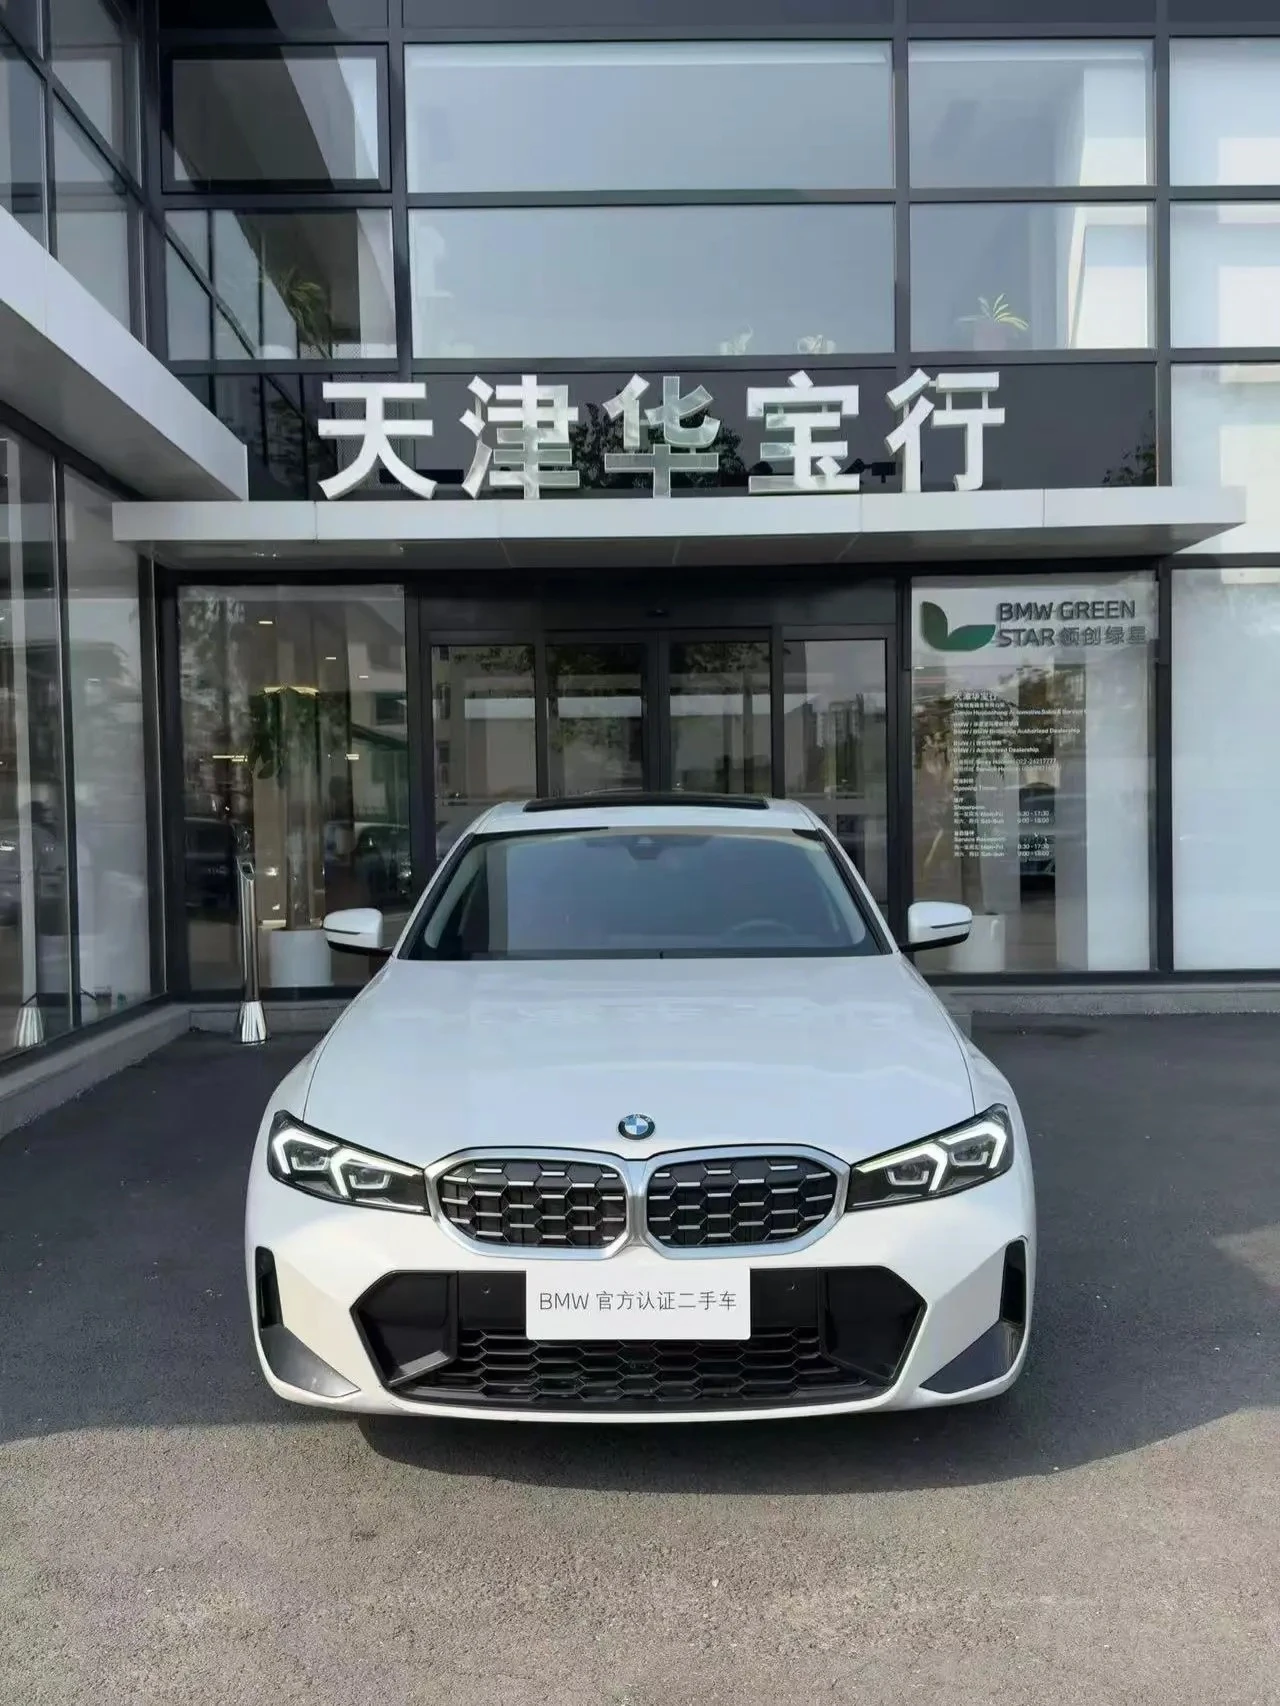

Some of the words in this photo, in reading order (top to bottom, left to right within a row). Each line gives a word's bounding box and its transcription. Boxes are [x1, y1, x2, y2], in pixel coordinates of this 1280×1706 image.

[317, 370, 1005, 500] 天津华宝行
[997, 601, 1054, 622] BMW
[1058, 600, 1136, 621] GREEN
[997, 628, 1055, 647] STAR
[1060, 626, 1146, 647] 领创绿星
[539, 1292, 590, 1311] BMW
[595, 1290, 738, 1312] 官方认证二手车
